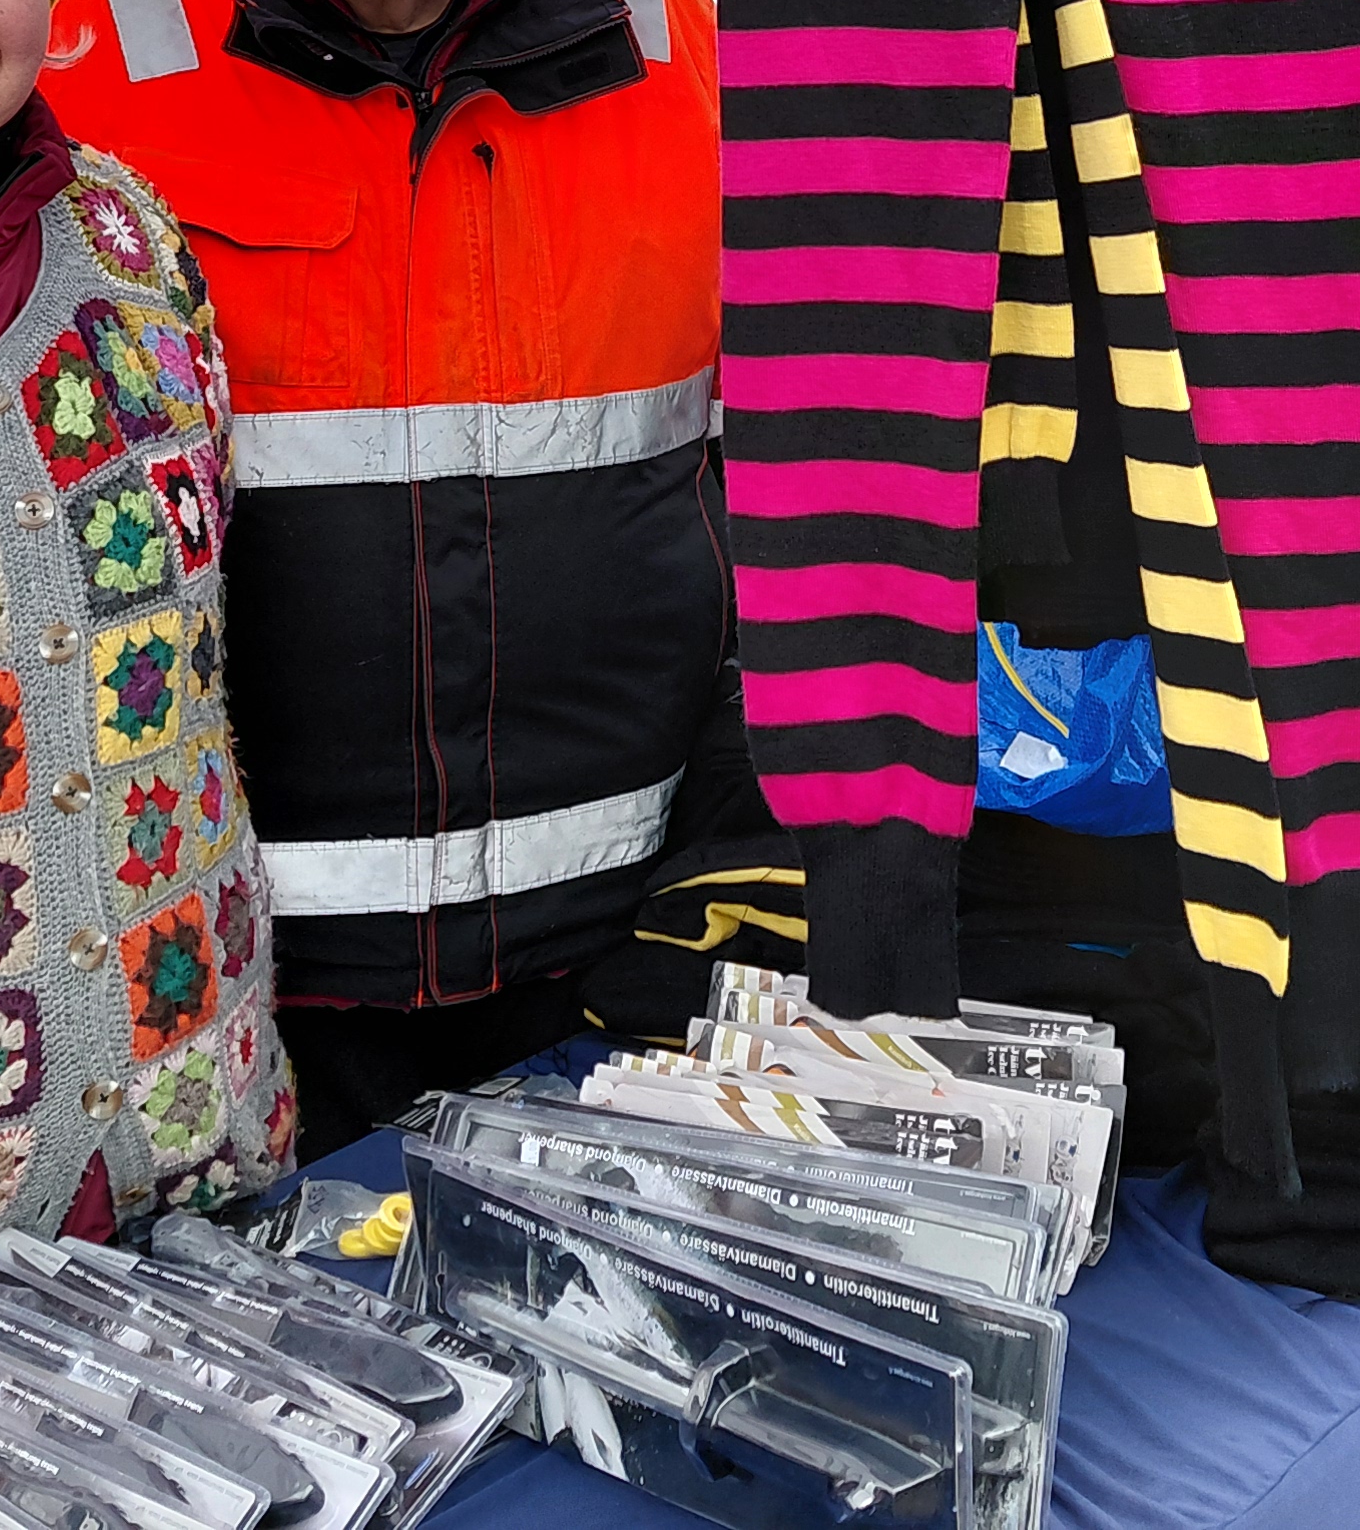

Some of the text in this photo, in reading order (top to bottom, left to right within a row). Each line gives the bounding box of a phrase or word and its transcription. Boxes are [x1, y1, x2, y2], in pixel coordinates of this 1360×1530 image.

[583, 1143, 647, 1173] Diamond
[671, 1165, 783, 1205] Diamantvässare
[806, 1196, 916, 1236] Timanttiteroitin
[679, 1233, 797, 1282] Diamantvässare
[480, 1200, 847, 1366] Timanttiteroitin Diamantvässare Diamond sharpener
[823, 1273, 941, 1325] Timanttiteroitin
